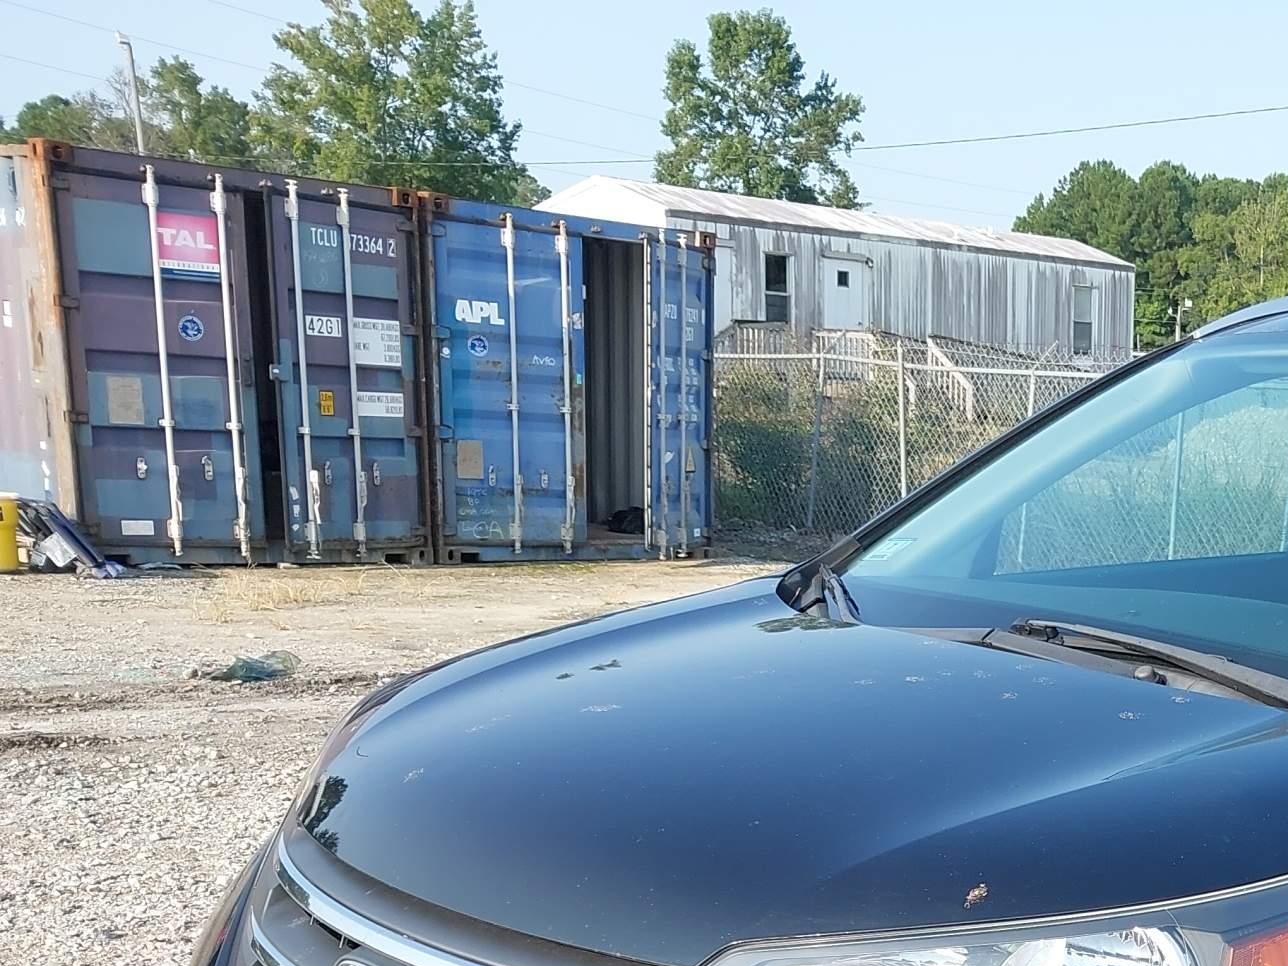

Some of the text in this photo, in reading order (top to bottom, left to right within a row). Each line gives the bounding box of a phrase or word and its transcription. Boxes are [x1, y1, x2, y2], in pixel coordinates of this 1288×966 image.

[157, 227, 217, 250] TAL
[310, 227, 397, 257] TCLU 73364 2
[455, 299, 505, 325] APL
[308, 317, 340, 335] 42G1
